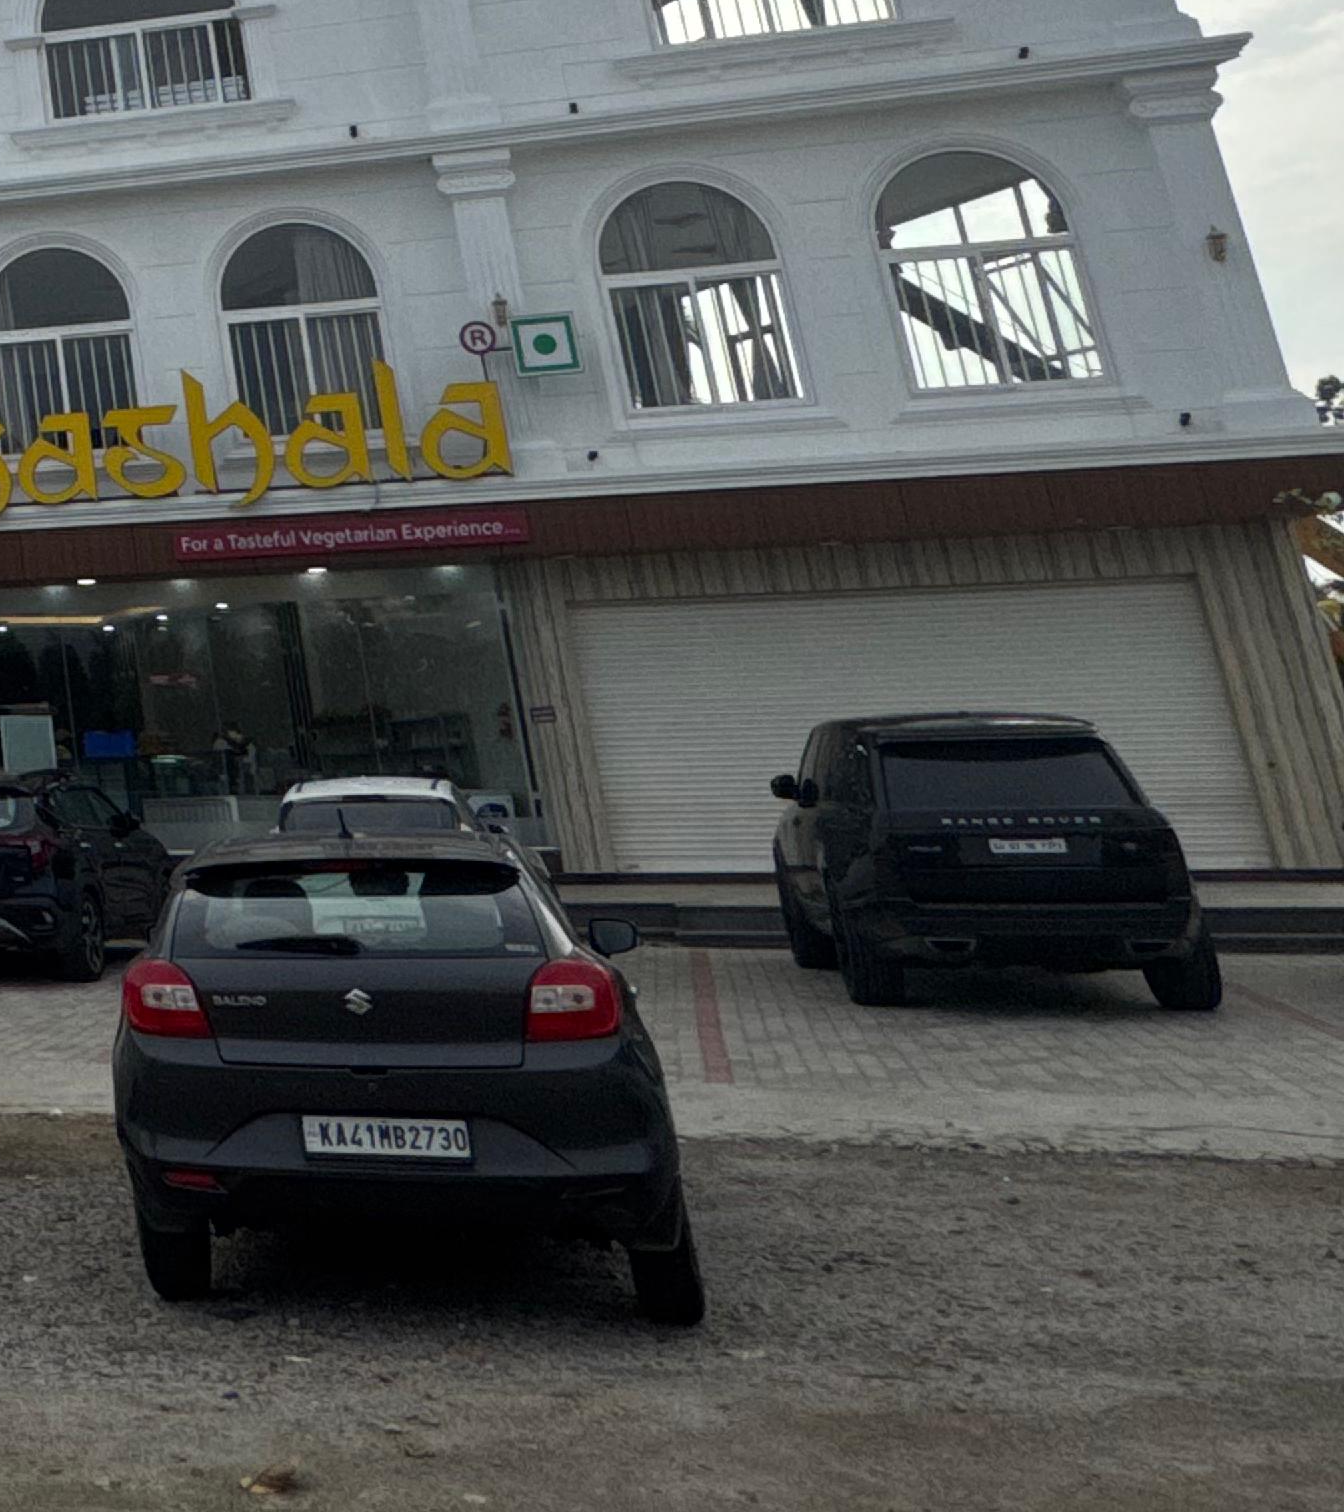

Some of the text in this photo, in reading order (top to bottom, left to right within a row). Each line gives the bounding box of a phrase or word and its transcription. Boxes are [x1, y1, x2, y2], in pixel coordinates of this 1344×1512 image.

[180, 535, 209, 553] For
[213, 537, 224, 550] a
[227, 529, 296, 551] Tasteful
[300, 524, 399, 549] Vegetarian
[317, 1121, 469, 1151] KA41MB2730
